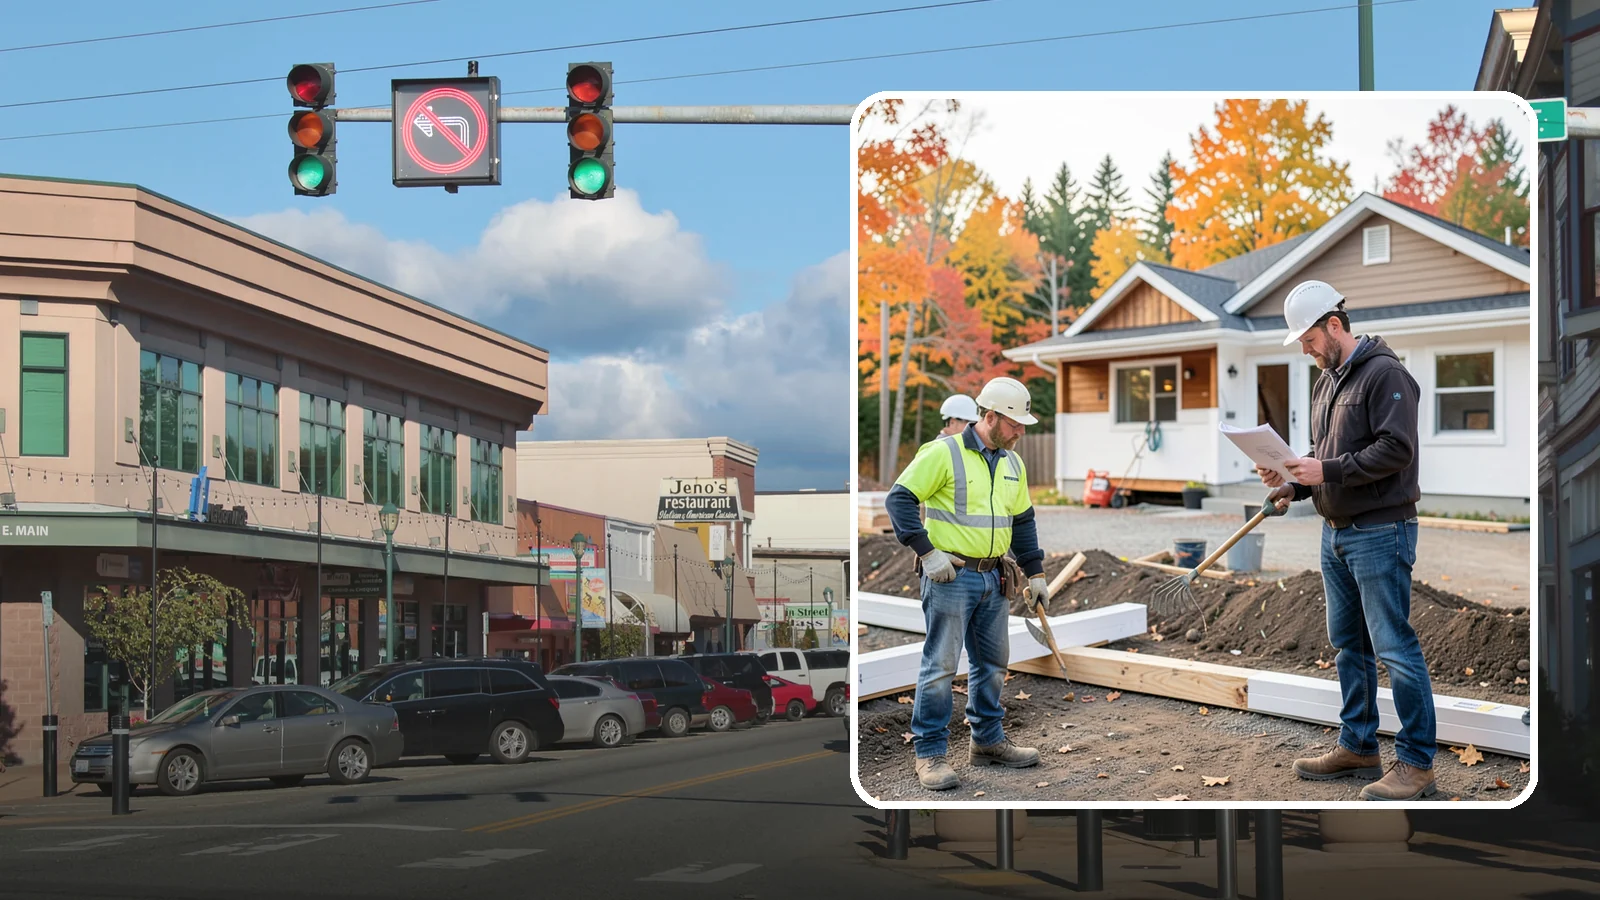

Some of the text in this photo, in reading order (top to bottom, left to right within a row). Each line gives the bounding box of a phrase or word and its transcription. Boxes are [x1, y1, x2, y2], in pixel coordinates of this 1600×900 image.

[669, 480, 727, 494] Jeno's
[665, 496, 731, 509] restaurant
[659, 510, 681, 519] Italian
[686, 510, 714, 519] American
[715, 510, 737, 519] Cuisine
[2, 525, 49, 536] E. MAIN
[786, 607, 828, 617] in Street
[791, 619, 823, 627] lass
